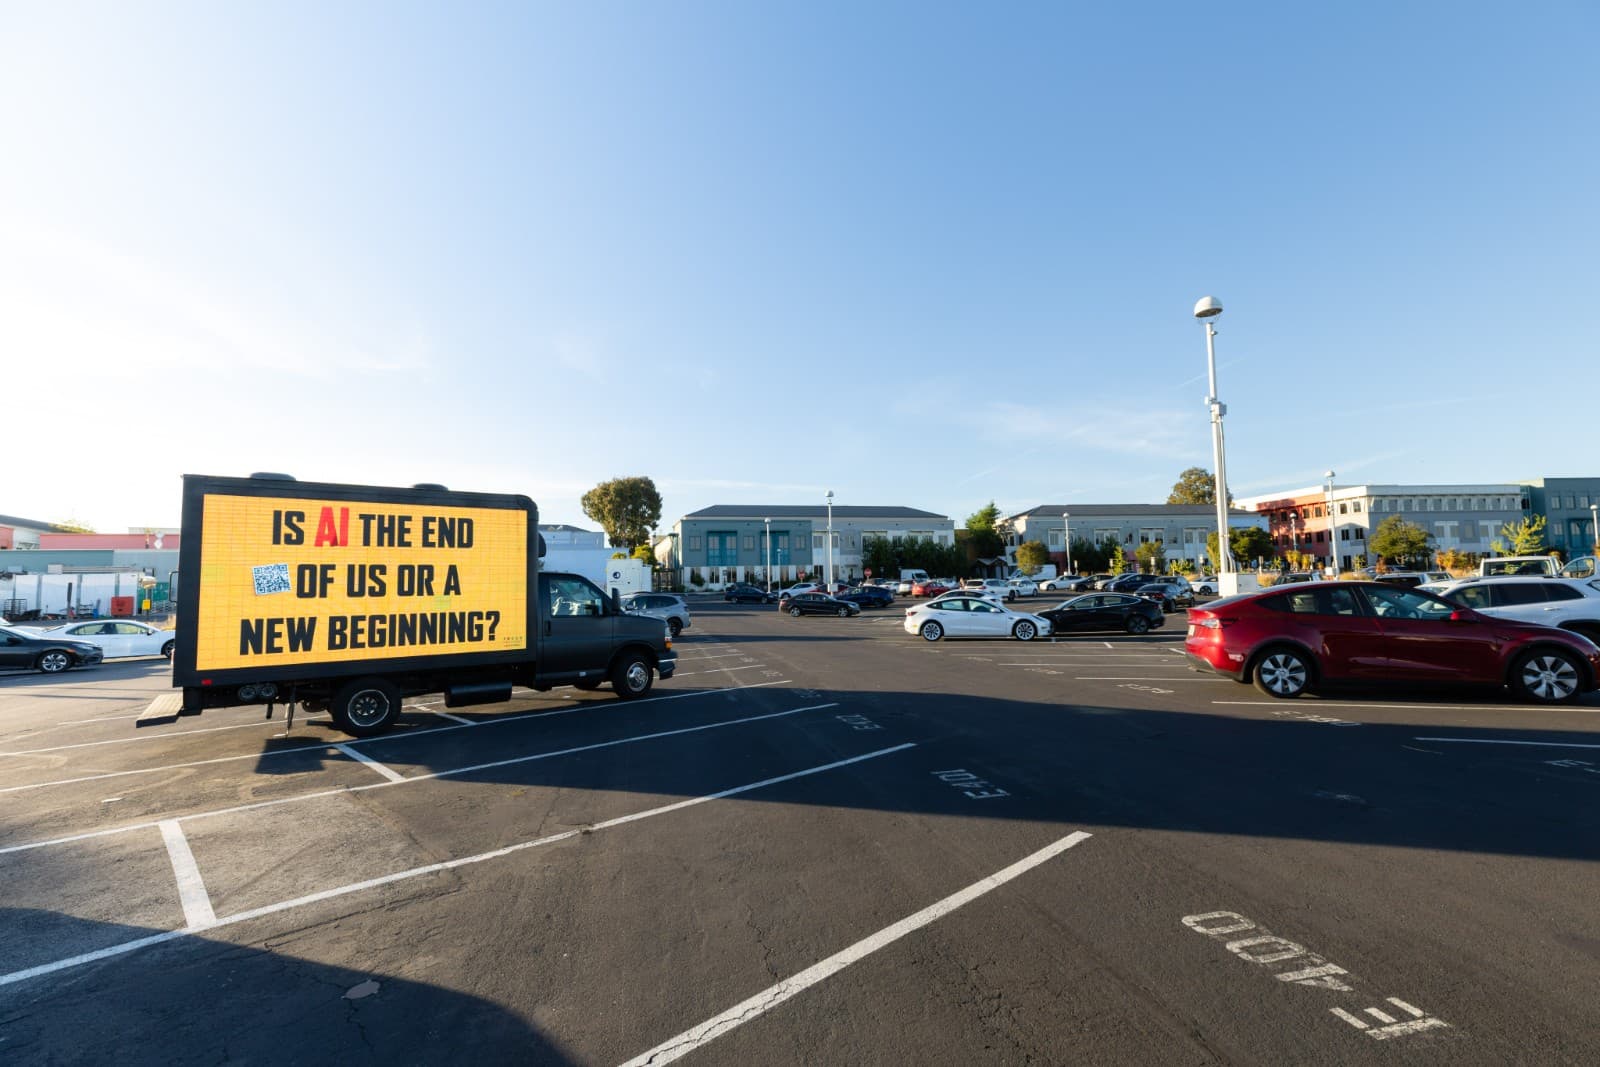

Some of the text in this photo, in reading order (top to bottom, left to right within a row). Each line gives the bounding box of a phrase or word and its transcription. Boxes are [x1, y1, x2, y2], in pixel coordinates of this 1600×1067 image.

[272, 506, 474, 549] IS AI THE END
[296, 564, 462, 599] OF US OR A
[239, 611, 501, 656] NEW BEGINNING?
